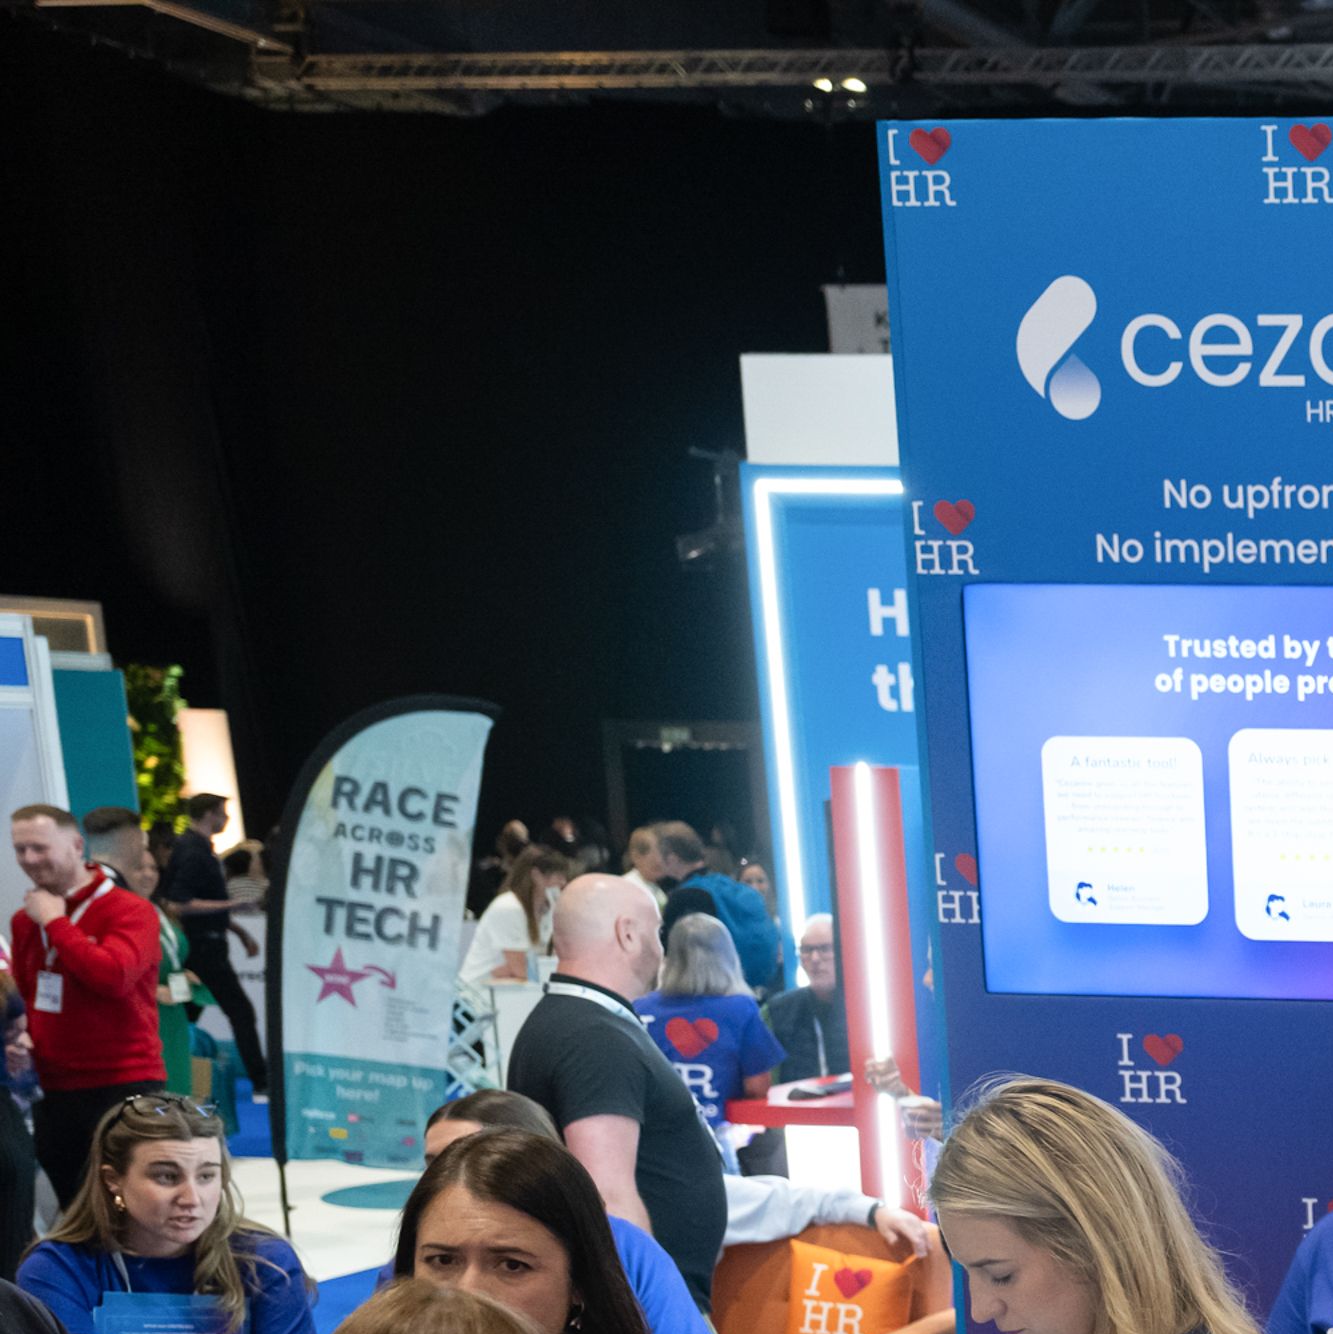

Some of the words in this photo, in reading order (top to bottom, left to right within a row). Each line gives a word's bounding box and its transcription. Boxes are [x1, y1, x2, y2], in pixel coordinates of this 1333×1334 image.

[1260, 125, 1278, 162] I
[890, 169, 956, 207] HR
[1162, 480, 1211, 510] No
[915, 539, 979, 576] HR
[1095, 533, 1142, 564] No
[1163, 633, 1279, 661] Trusted
[1284, 634, 1320, 667] by
[1154, 669, 1184, 694] of
[1189, 671, 1290, 701] people
[1085, 755, 1141, 769] fantastic
[1247, 752, 1299, 766] Always
[330, 775, 461, 830] RACE
[350, 851, 422, 899] HR
[315, 896, 442, 952] TECH
[1117, 1033, 1135, 1066] I
[294, 1061, 328, 1080] Pick
[329, 1066, 365, 1085] your
[368, 1070, 410, 1091] map
[411, 1074, 435, 1092] up
[1119, 1071, 1187, 1104] HR
[335, 1085, 381, 1103] here!
[804, 1262, 830, 1297] I
